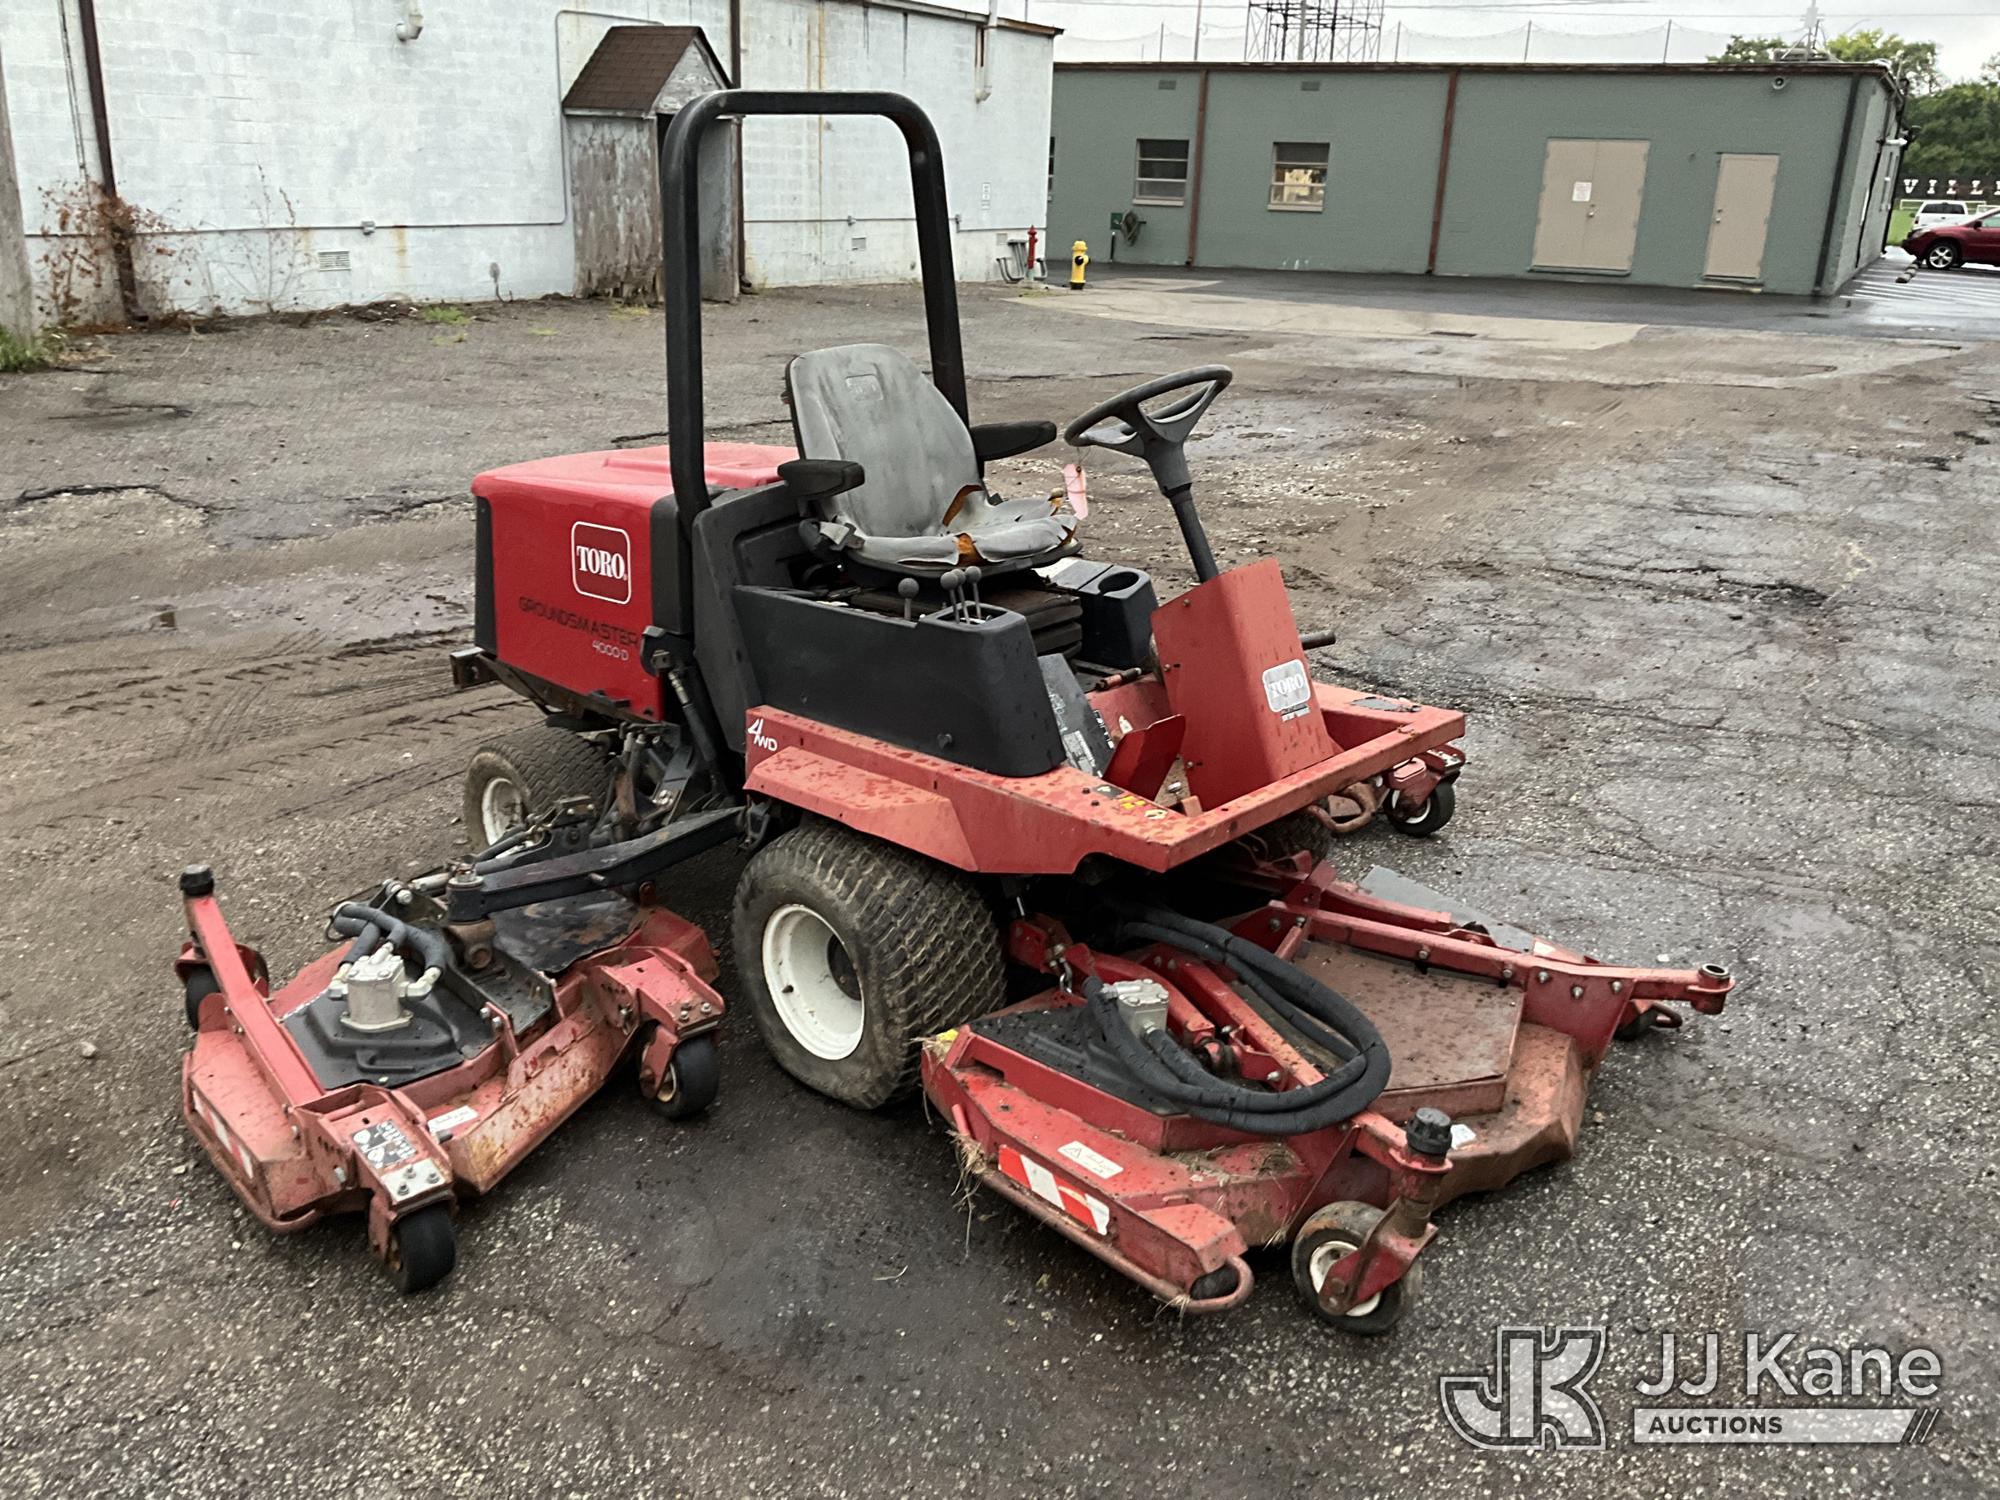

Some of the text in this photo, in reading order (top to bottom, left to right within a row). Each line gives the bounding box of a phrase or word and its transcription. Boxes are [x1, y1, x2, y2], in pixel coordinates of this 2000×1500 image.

[576, 545, 625, 580] TORO
[519, 596, 642, 648] GROUNDSMASTER
[1269, 673, 1304, 698] TORO
